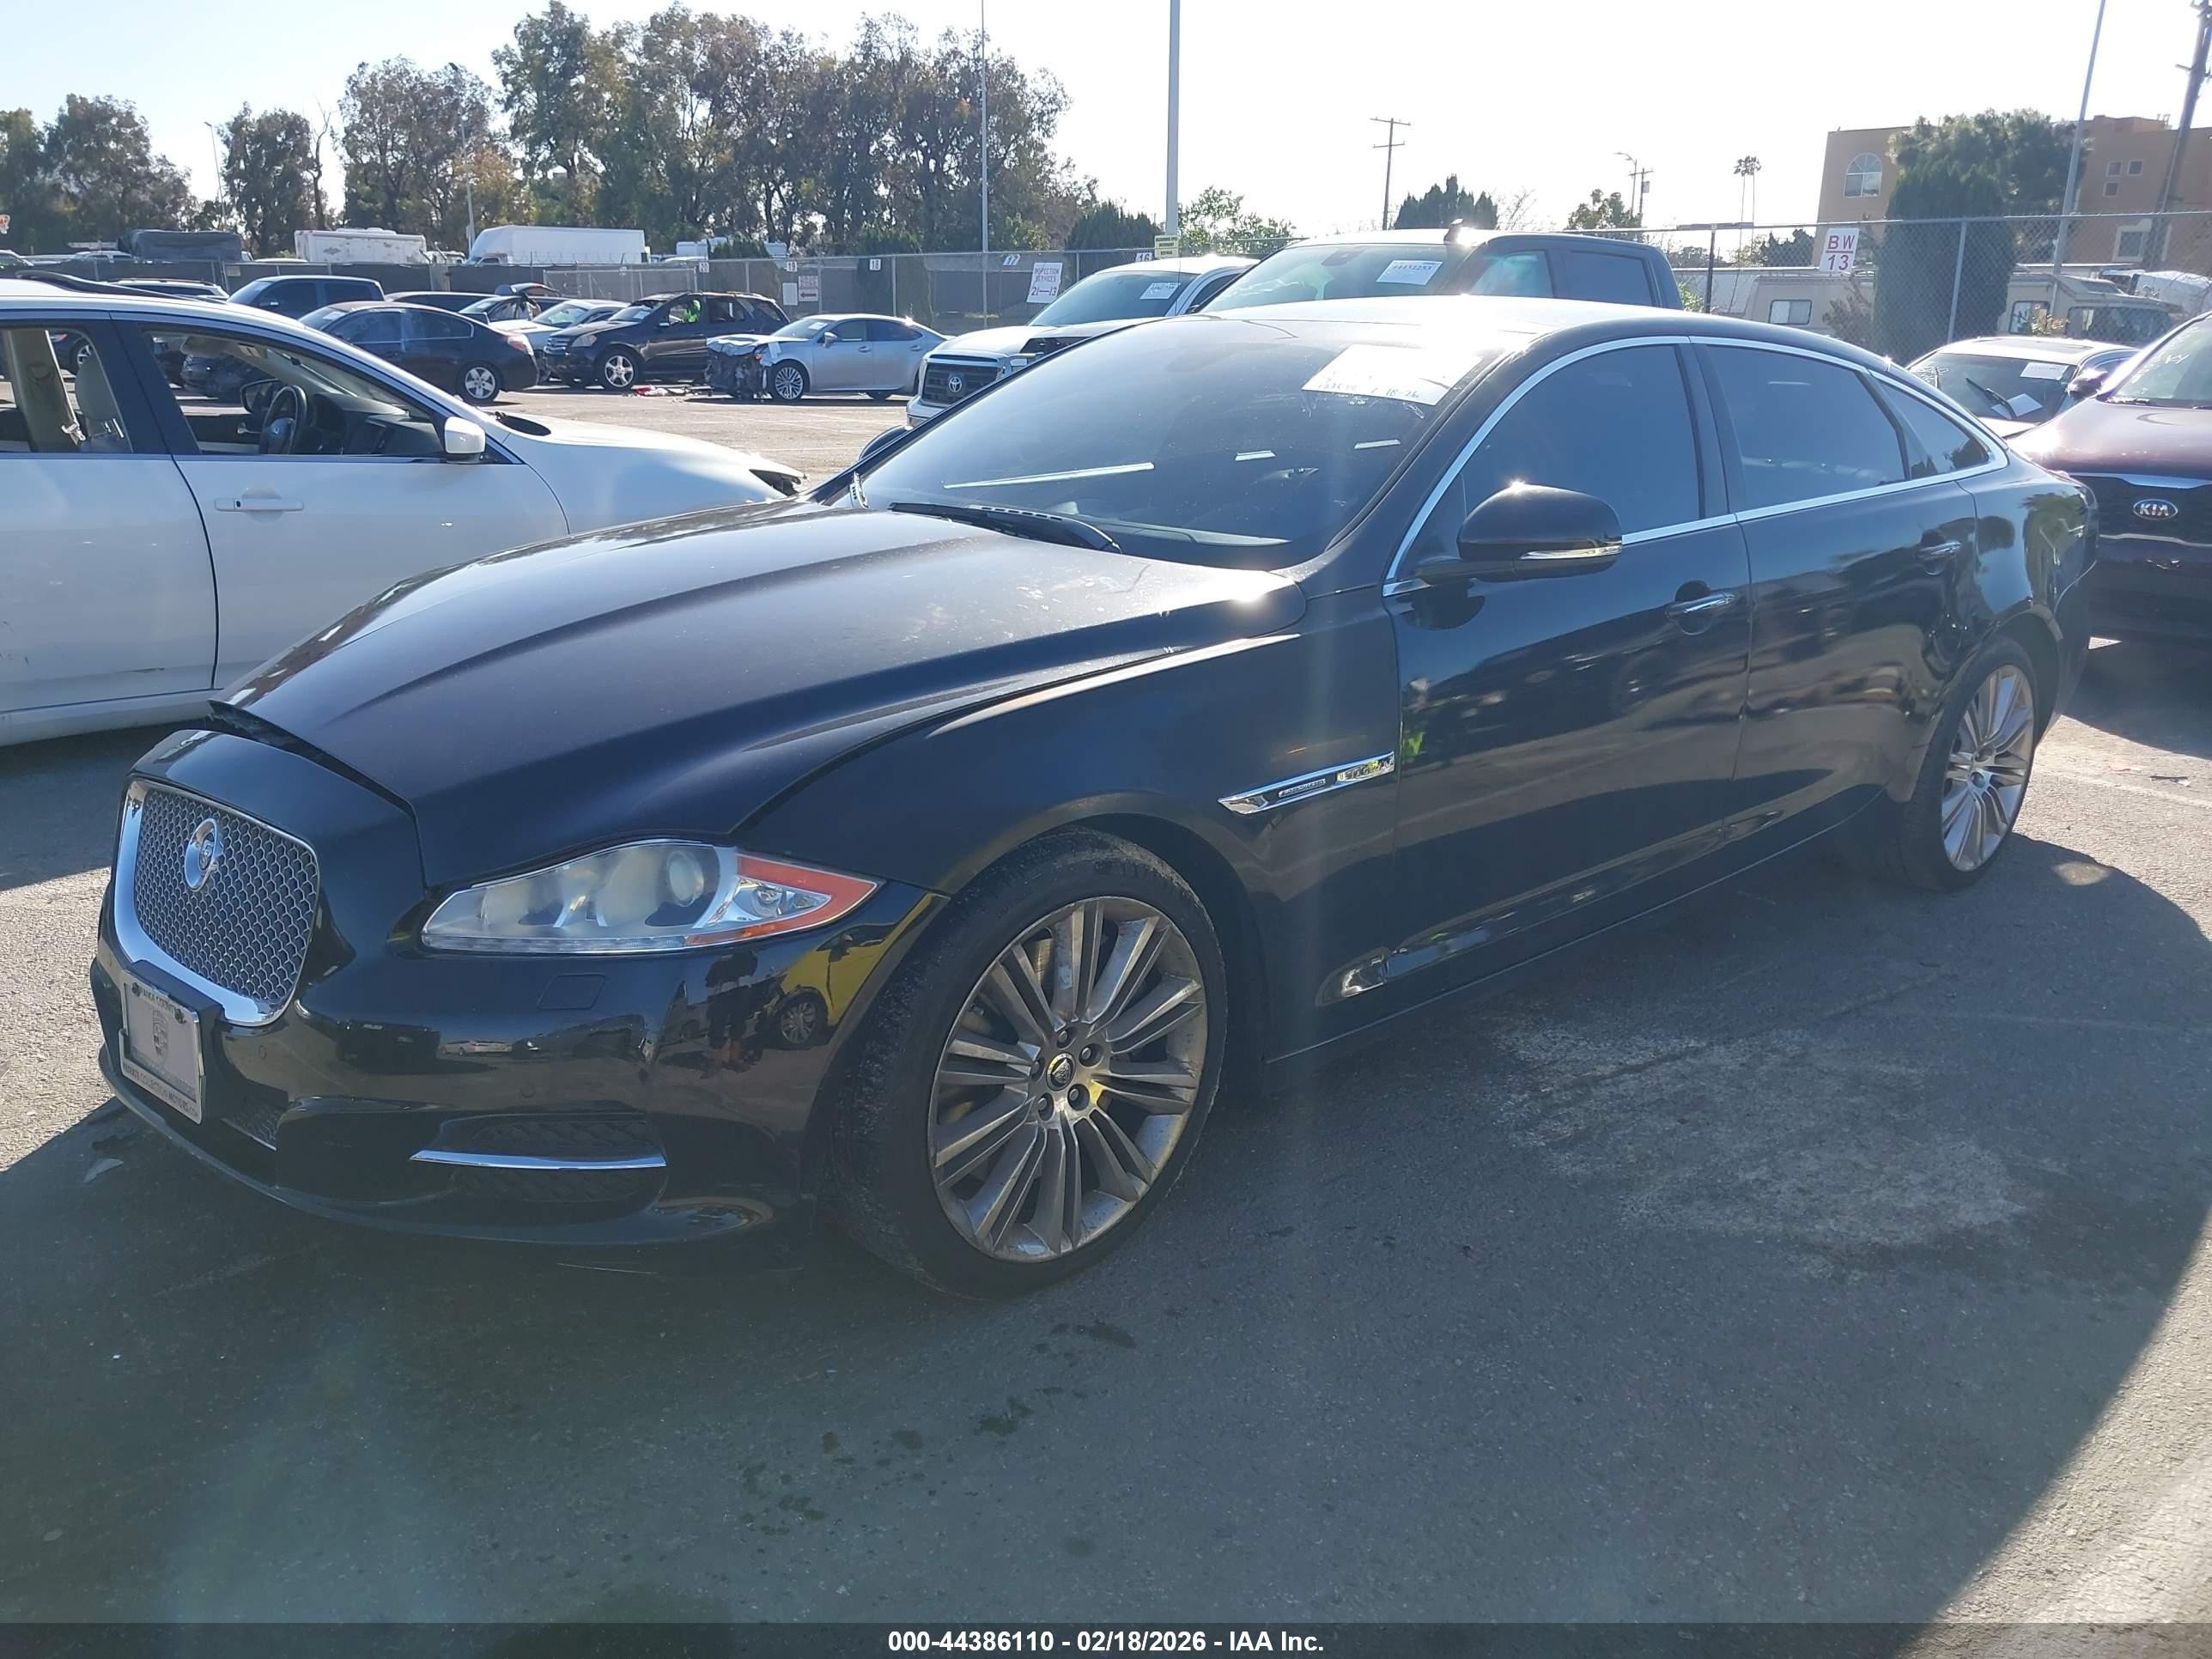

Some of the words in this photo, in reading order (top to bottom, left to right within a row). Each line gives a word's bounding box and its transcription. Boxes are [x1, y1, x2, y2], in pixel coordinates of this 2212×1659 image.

[1827, 235, 1856, 249] BW
[1828, 254, 1849, 270] 13
[2139, 503, 2169, 516] KIA
